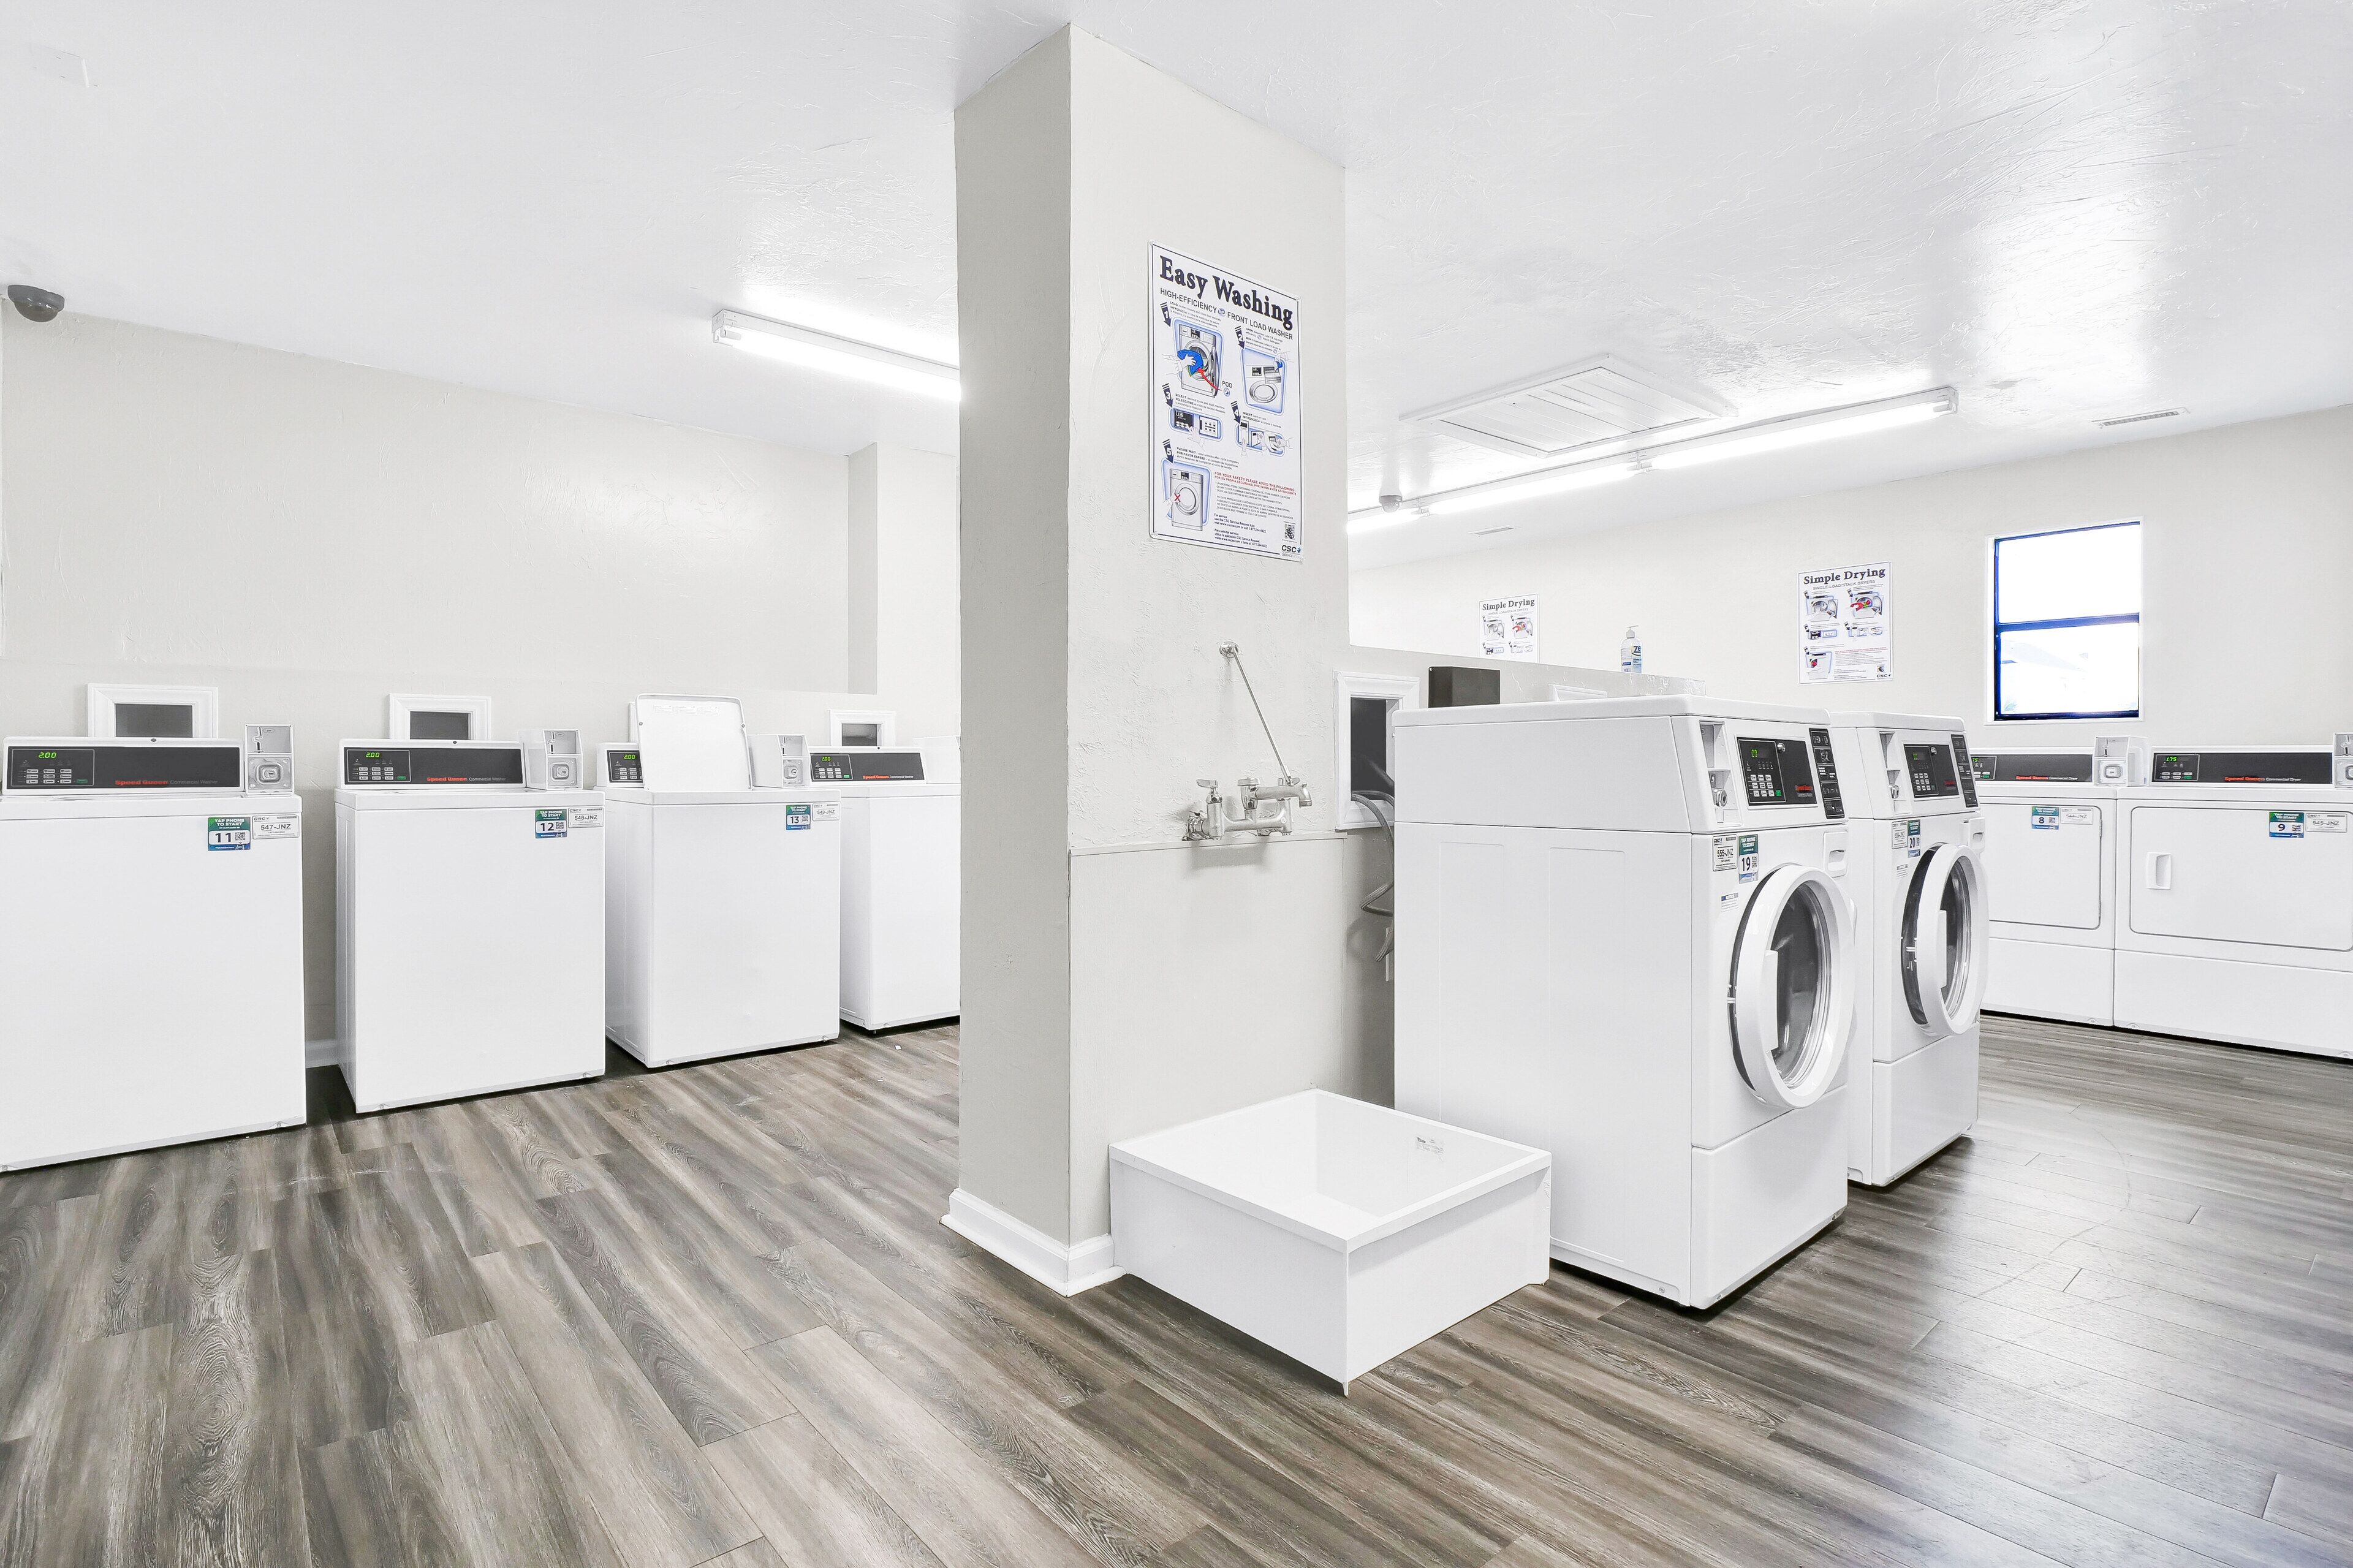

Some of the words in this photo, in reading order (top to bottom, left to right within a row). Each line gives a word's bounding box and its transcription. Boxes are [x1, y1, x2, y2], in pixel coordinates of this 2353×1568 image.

[1160, 255, 1208, 300] Easy
[1212, 275, 1293, 331] Washing
[1160, 287, 1217, 314] HIGH-EFFICIENCY
[1227, 311, 1248, 325] FRONT
[1250, 319, 1267, 331] LOAD
[1268, 325, 1293, 340] WASHER
[1164, 310, 1169, 319] 1
[1238, 333, 1243, 342] 2
[1165, 391, 1171, 400] 3
[1166, 447, 1172, 456] 5
[1803, 572, 1841, 585] Simple
[1843, 569, 1885, 580] Drying
[1482, 601, 1506, 611] Simple
[1508, 599, 1535, 608] Drying
[540, 822, 554, 831] 12
[215, 832, 231, 843] 11
[1909, 837, 1915, 849] 20
[1717, 848, 1733, 857] 555-JNZ
[1741, 857, 1751, 871] 19
